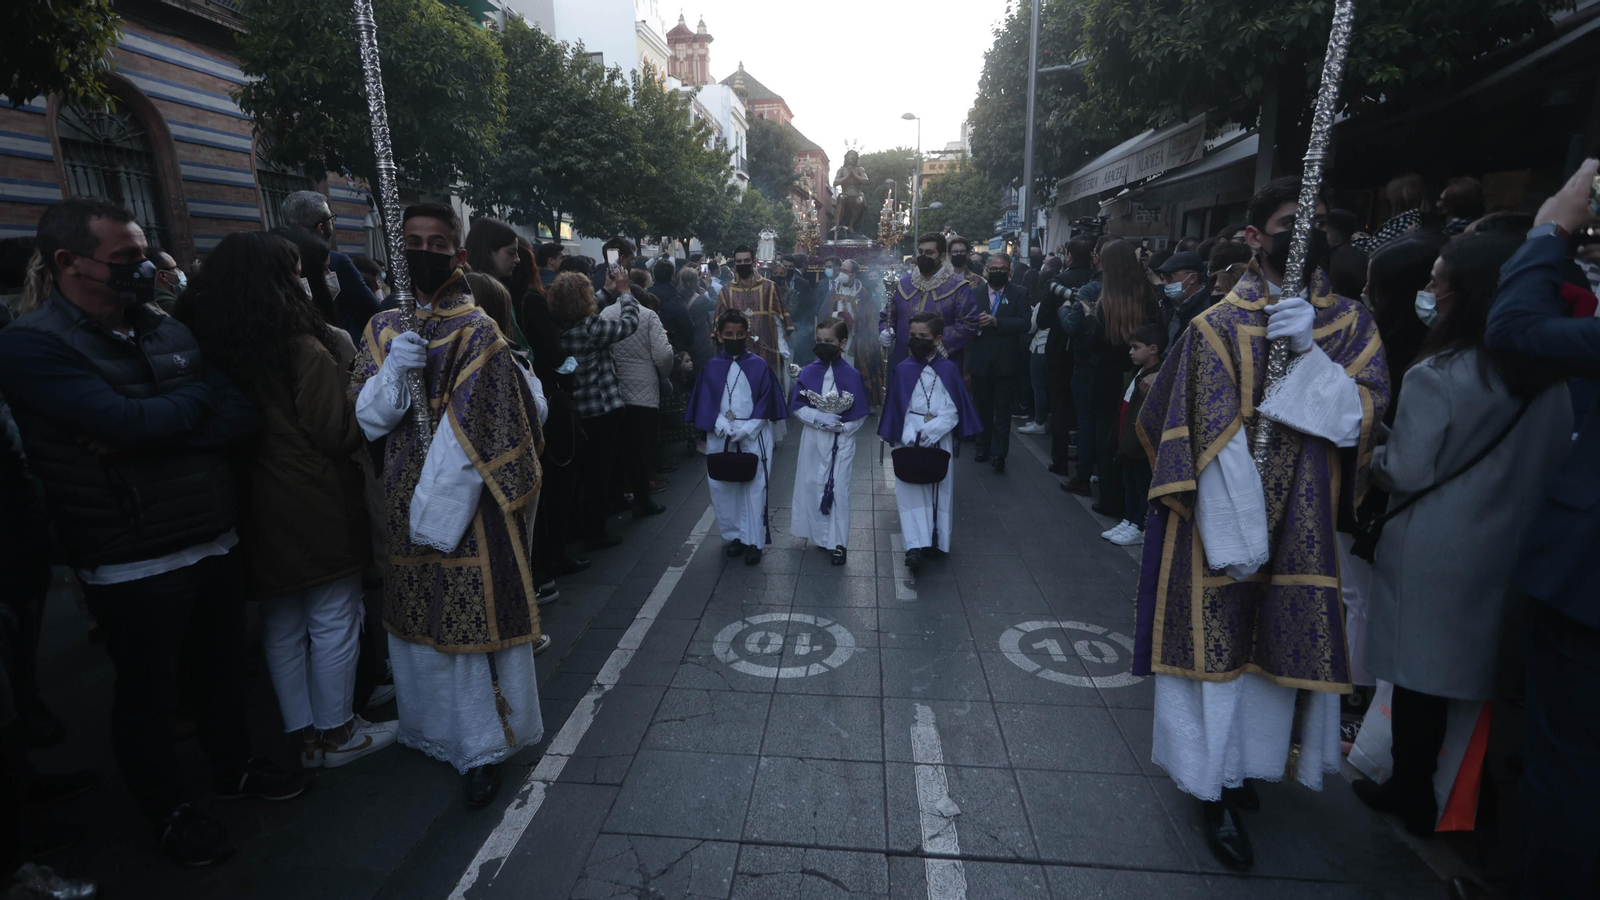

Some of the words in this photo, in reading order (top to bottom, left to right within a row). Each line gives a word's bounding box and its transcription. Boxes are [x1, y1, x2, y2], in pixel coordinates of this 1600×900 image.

[1103, 164, 1129, 185] ABACERIA
[1137, 149, 1163, 173] ALBOREA
[1031, 638, 1119, 664] 10
